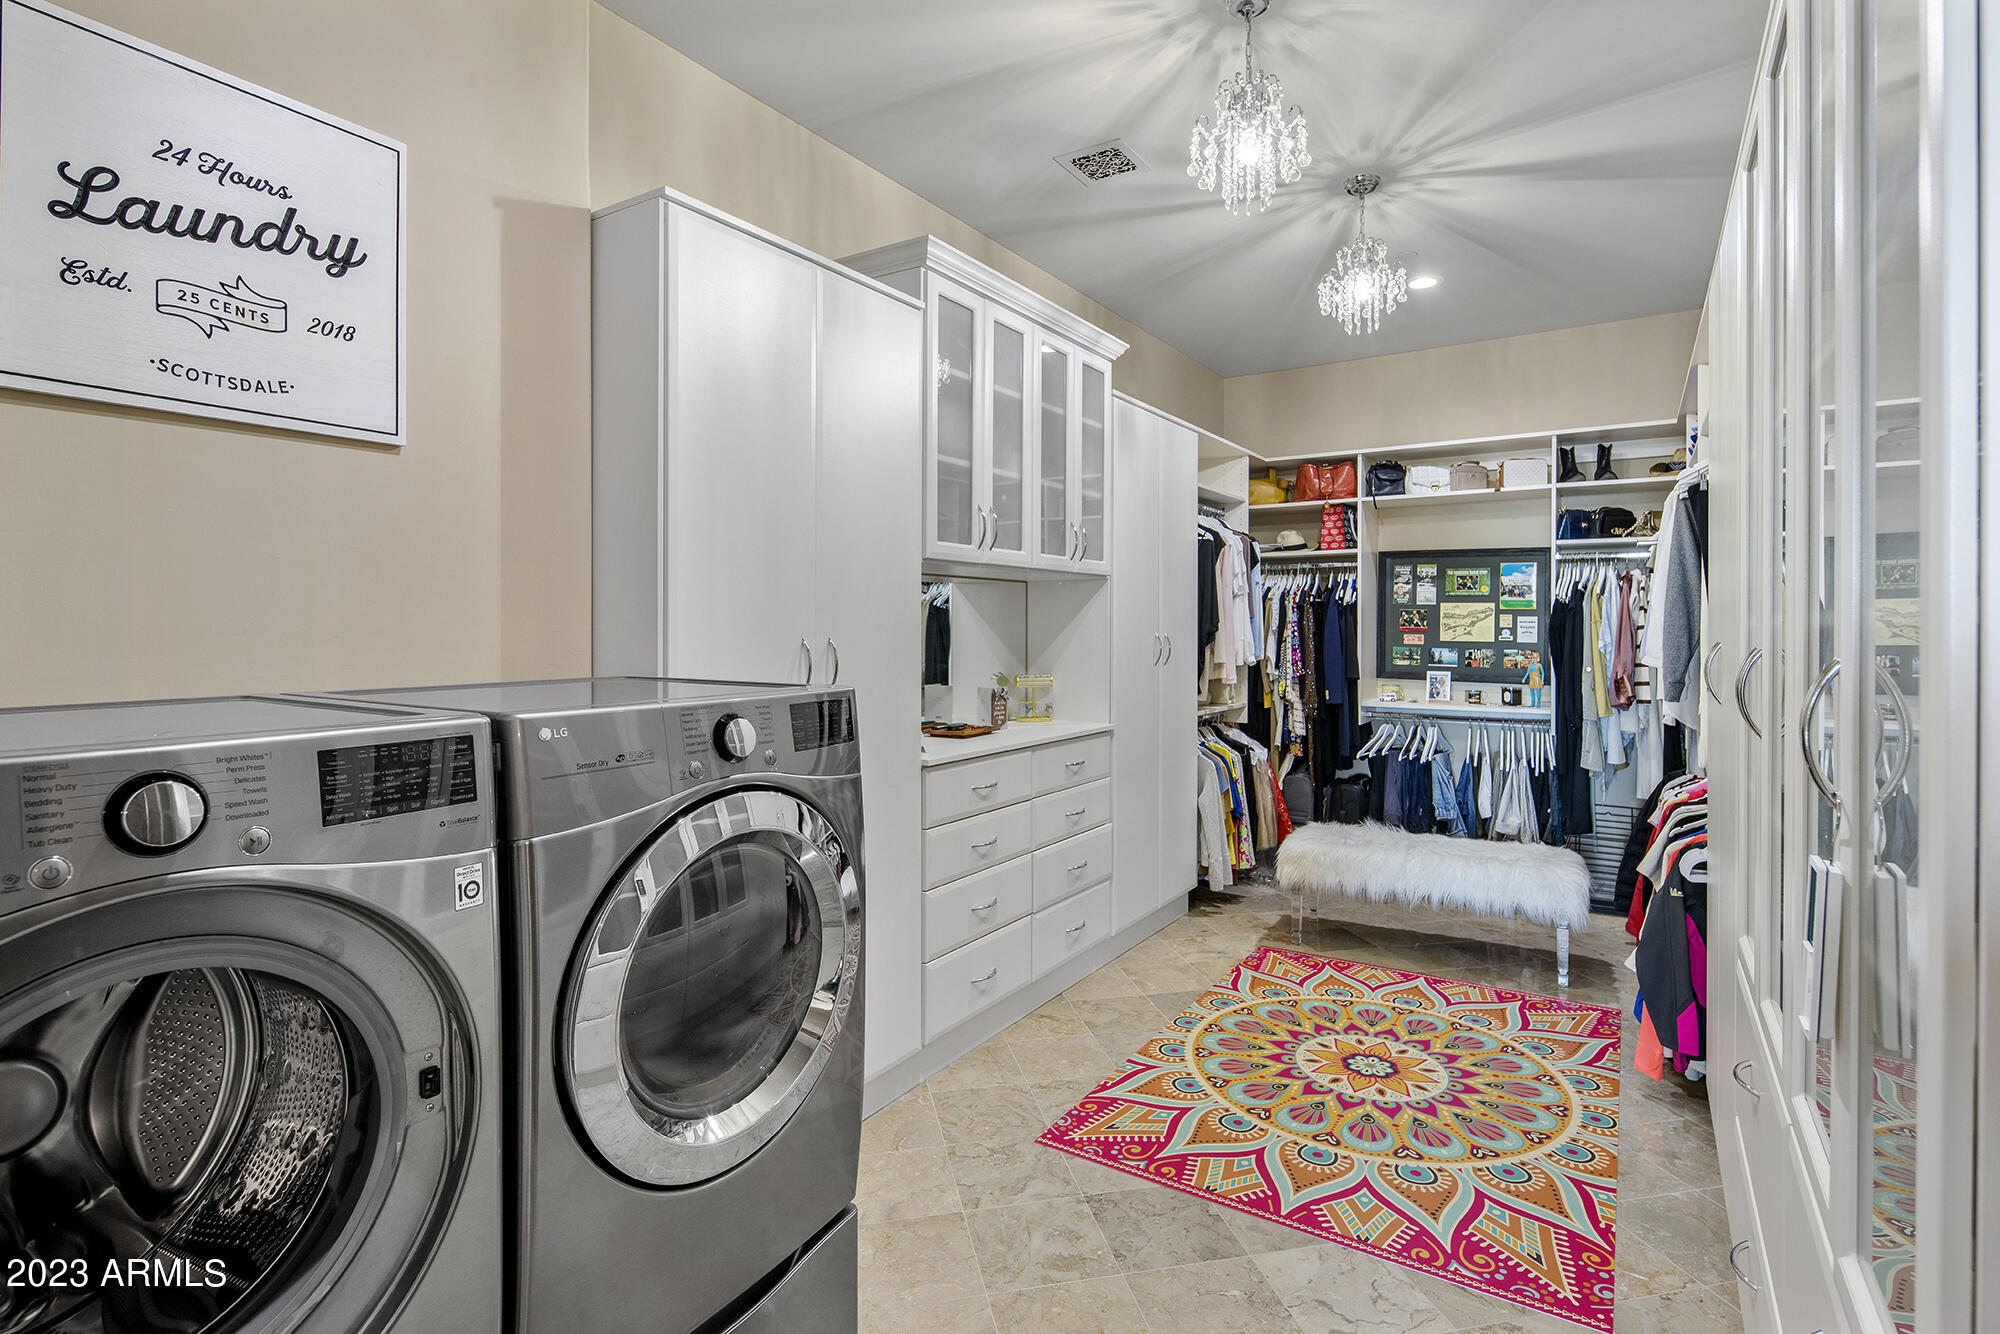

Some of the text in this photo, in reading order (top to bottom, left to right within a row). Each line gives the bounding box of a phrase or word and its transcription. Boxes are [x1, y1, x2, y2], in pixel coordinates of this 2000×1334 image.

[152, 139, 293, 200] 24 Hours
[47, 160, 368, 278] Laundry
[59, 256, 133, 293] Estd.
[177, 289, 271, 324] 25 CENTS
[306, 317, 357, 342] 2018
[553, 727, 568, 738] LG
[216, 755, 239, 764] Bright
[576, 759, 609, 770] Sensor Dry
[246, 764, 266, 772] Press
[23, 773, 57, 783] Normal
[234, 775, 267, 784] Delicates
[23, 783, 77, 795] Heavy Duty
[242, 786, 268, 795] Towels
[24, 798, 63, 809] Bedding
[224, 798, 269, 810] Speed Wash
[25, 810, 66, 821] Sanitary
[225, 809, 270, 821] Downloaded
[28, 837, 74, 849] Tub Clean
[457, 880, 481, 903] 10
